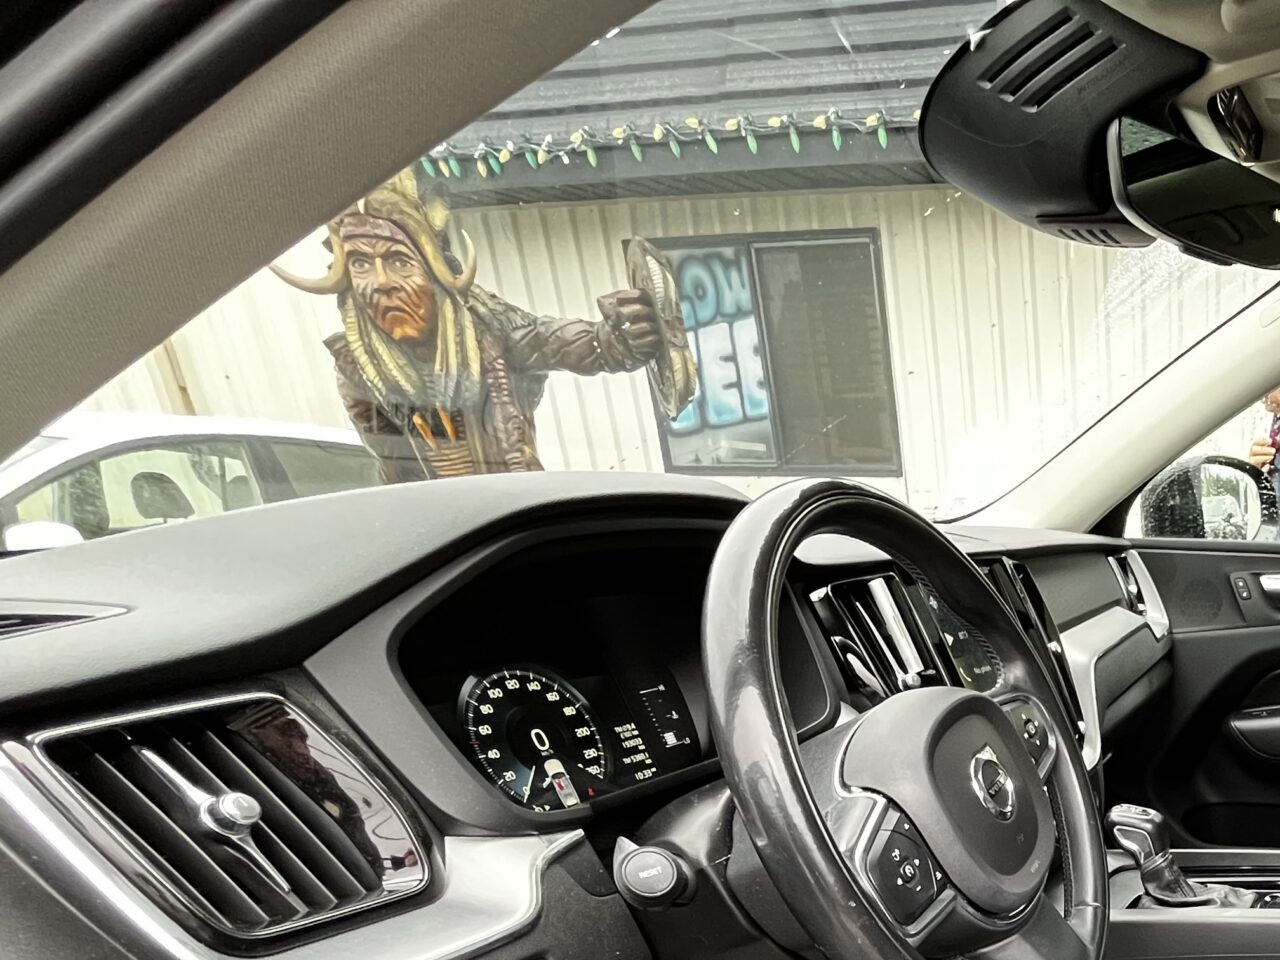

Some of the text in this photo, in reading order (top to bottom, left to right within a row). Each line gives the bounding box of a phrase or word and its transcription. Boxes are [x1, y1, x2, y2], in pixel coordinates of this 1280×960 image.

[487, 688, 503, 699] 100
[479, 704, 494, 715] 80
[478, 724, 493, 736] 60
[574, 726, 591, 738] 200
[530, 728, 550, 751] 0
[487, 748, 501, 760] 40
[502, 770, 516, 782] 20
